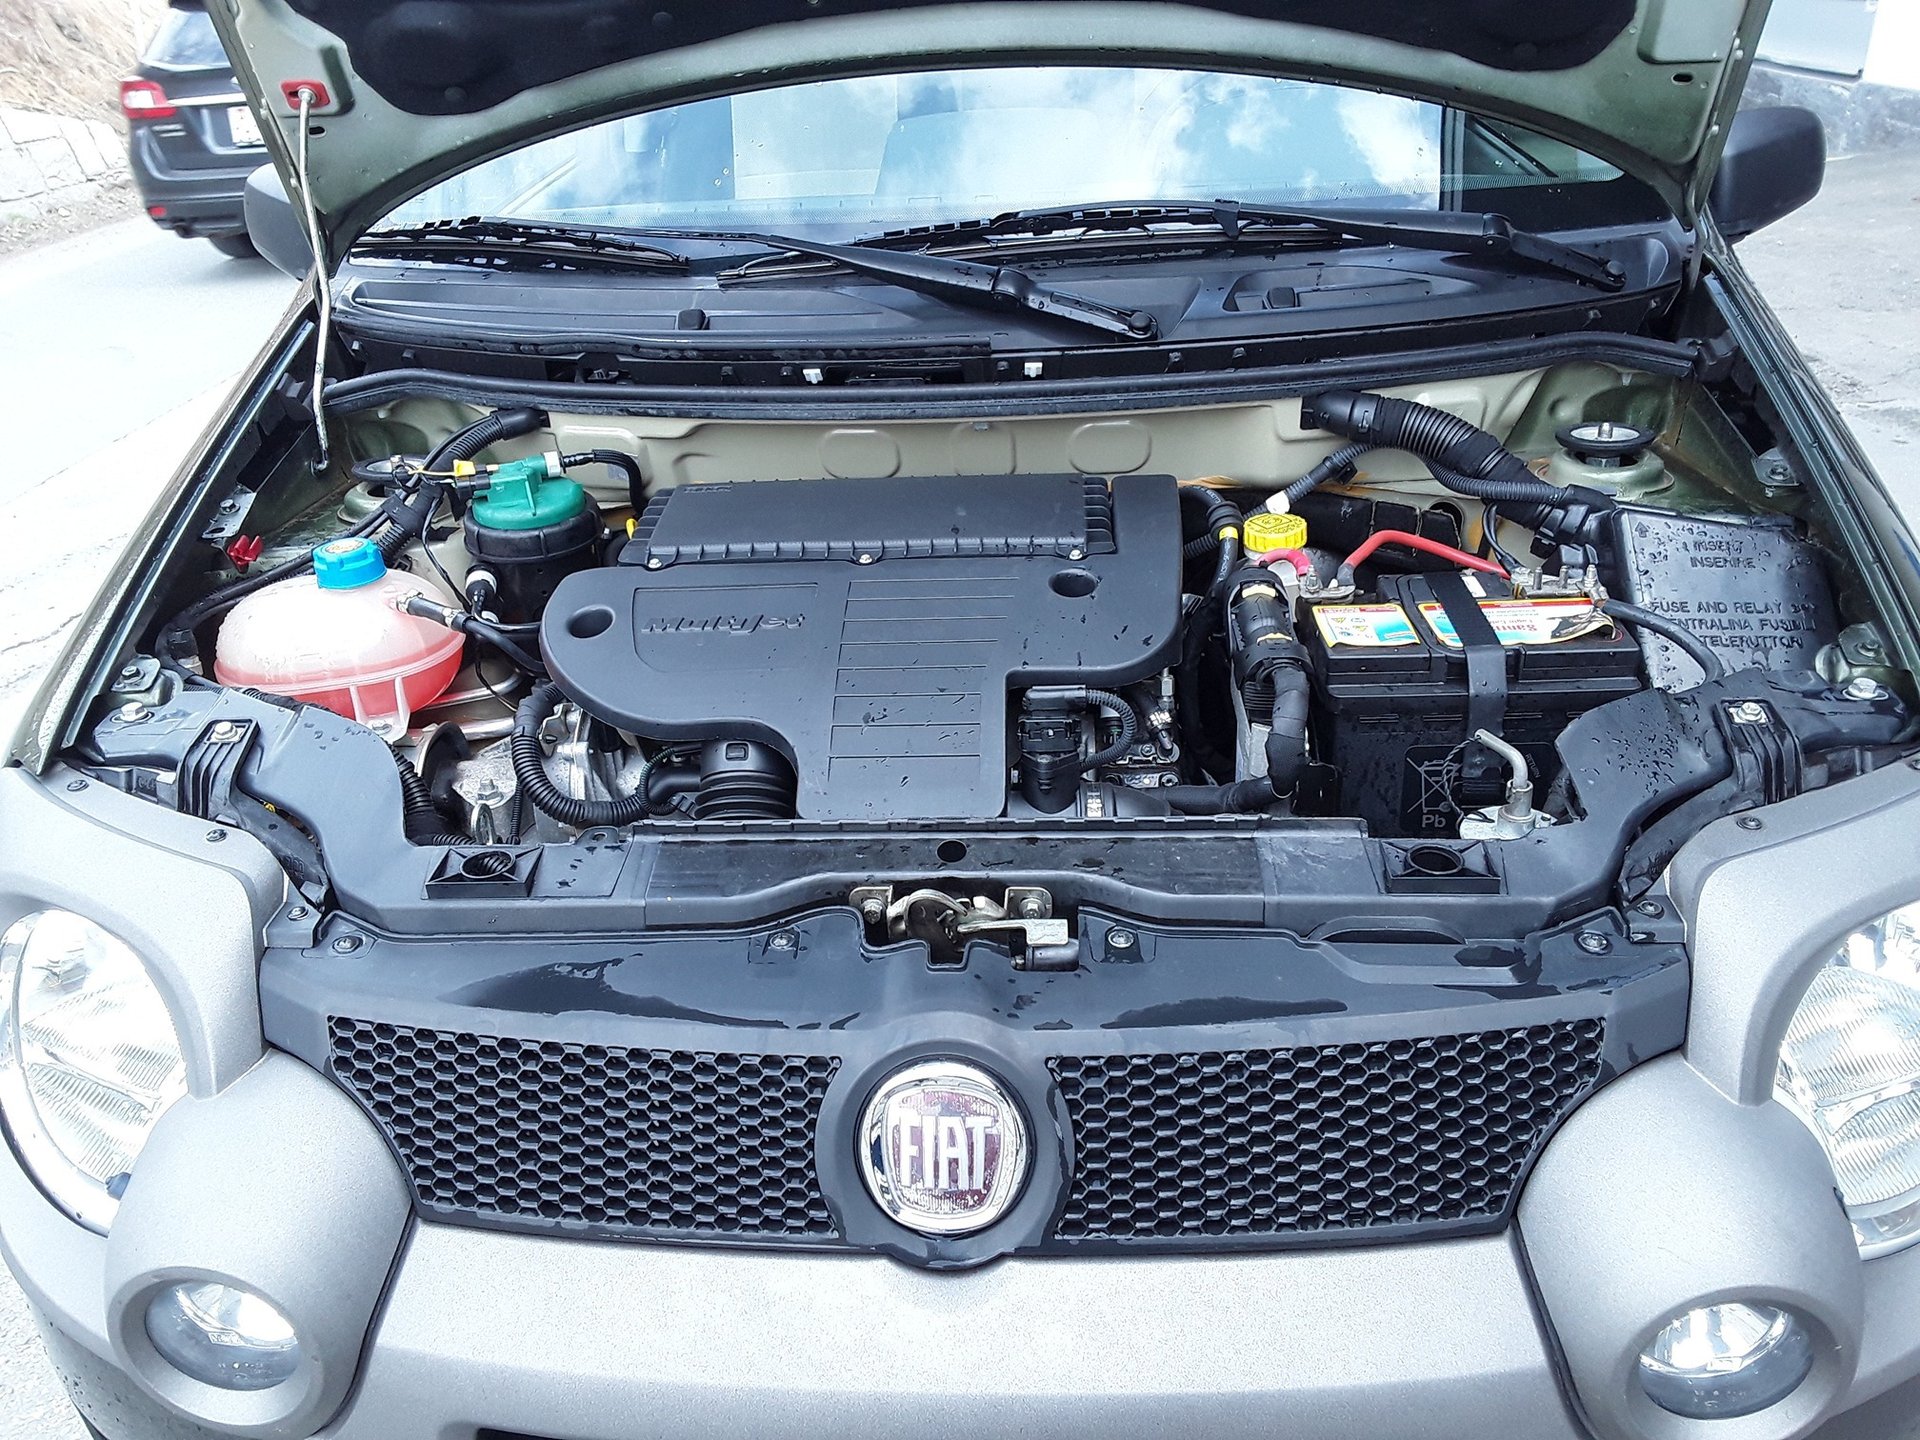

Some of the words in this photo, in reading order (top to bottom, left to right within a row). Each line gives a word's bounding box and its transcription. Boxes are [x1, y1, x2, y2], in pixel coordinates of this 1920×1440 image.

[1651, 601, 1690, 613] FUSE
[1697, 601, 1728, 613] AND
[1733, 602, 1782, 614] RELAY
[1422, 814, 1446, 828] Pb
[897, 1112, 995, 1192] FIAT
